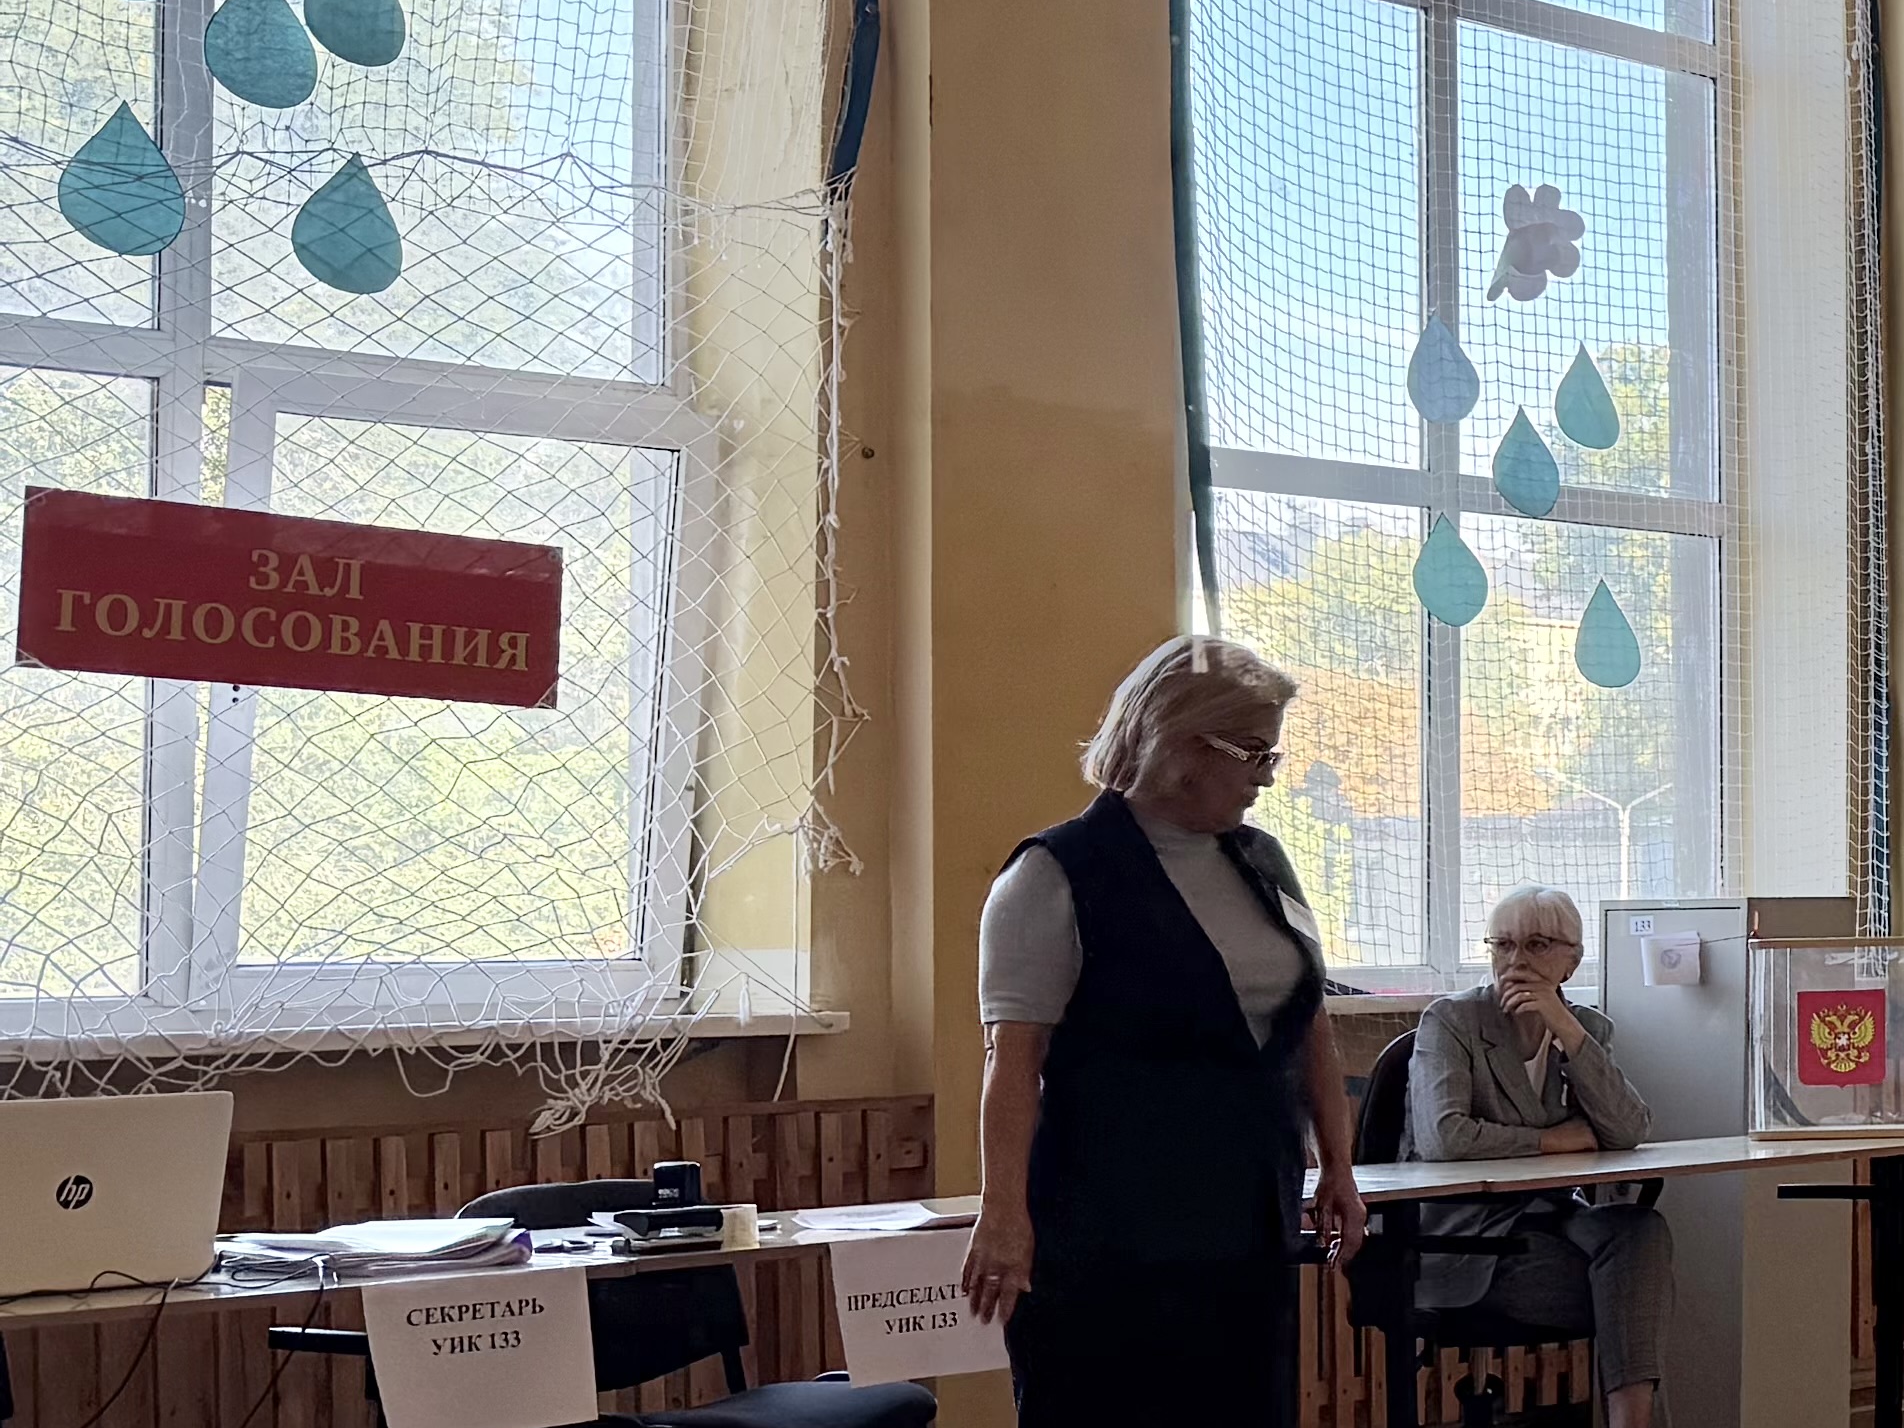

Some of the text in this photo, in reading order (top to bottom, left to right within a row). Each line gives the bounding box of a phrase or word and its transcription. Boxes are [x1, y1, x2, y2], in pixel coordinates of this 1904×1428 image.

[249, 549, 365, 600] ЗАЛ
[56, 589, 530, 671] ГОЛОСОВАНИЯ
[1635, 920, 1651, 932] 133
[57, 1175, 92, 1210] hp
[406, 1297, 545, 1326] СЕКРЕТАРЬ
[848, 1283, 968, 1312] ПРЕДСЕДАТ
[885, 1311, 958, 1335] УИК 133
[432, 1330, 521, 1355] УИК 133
